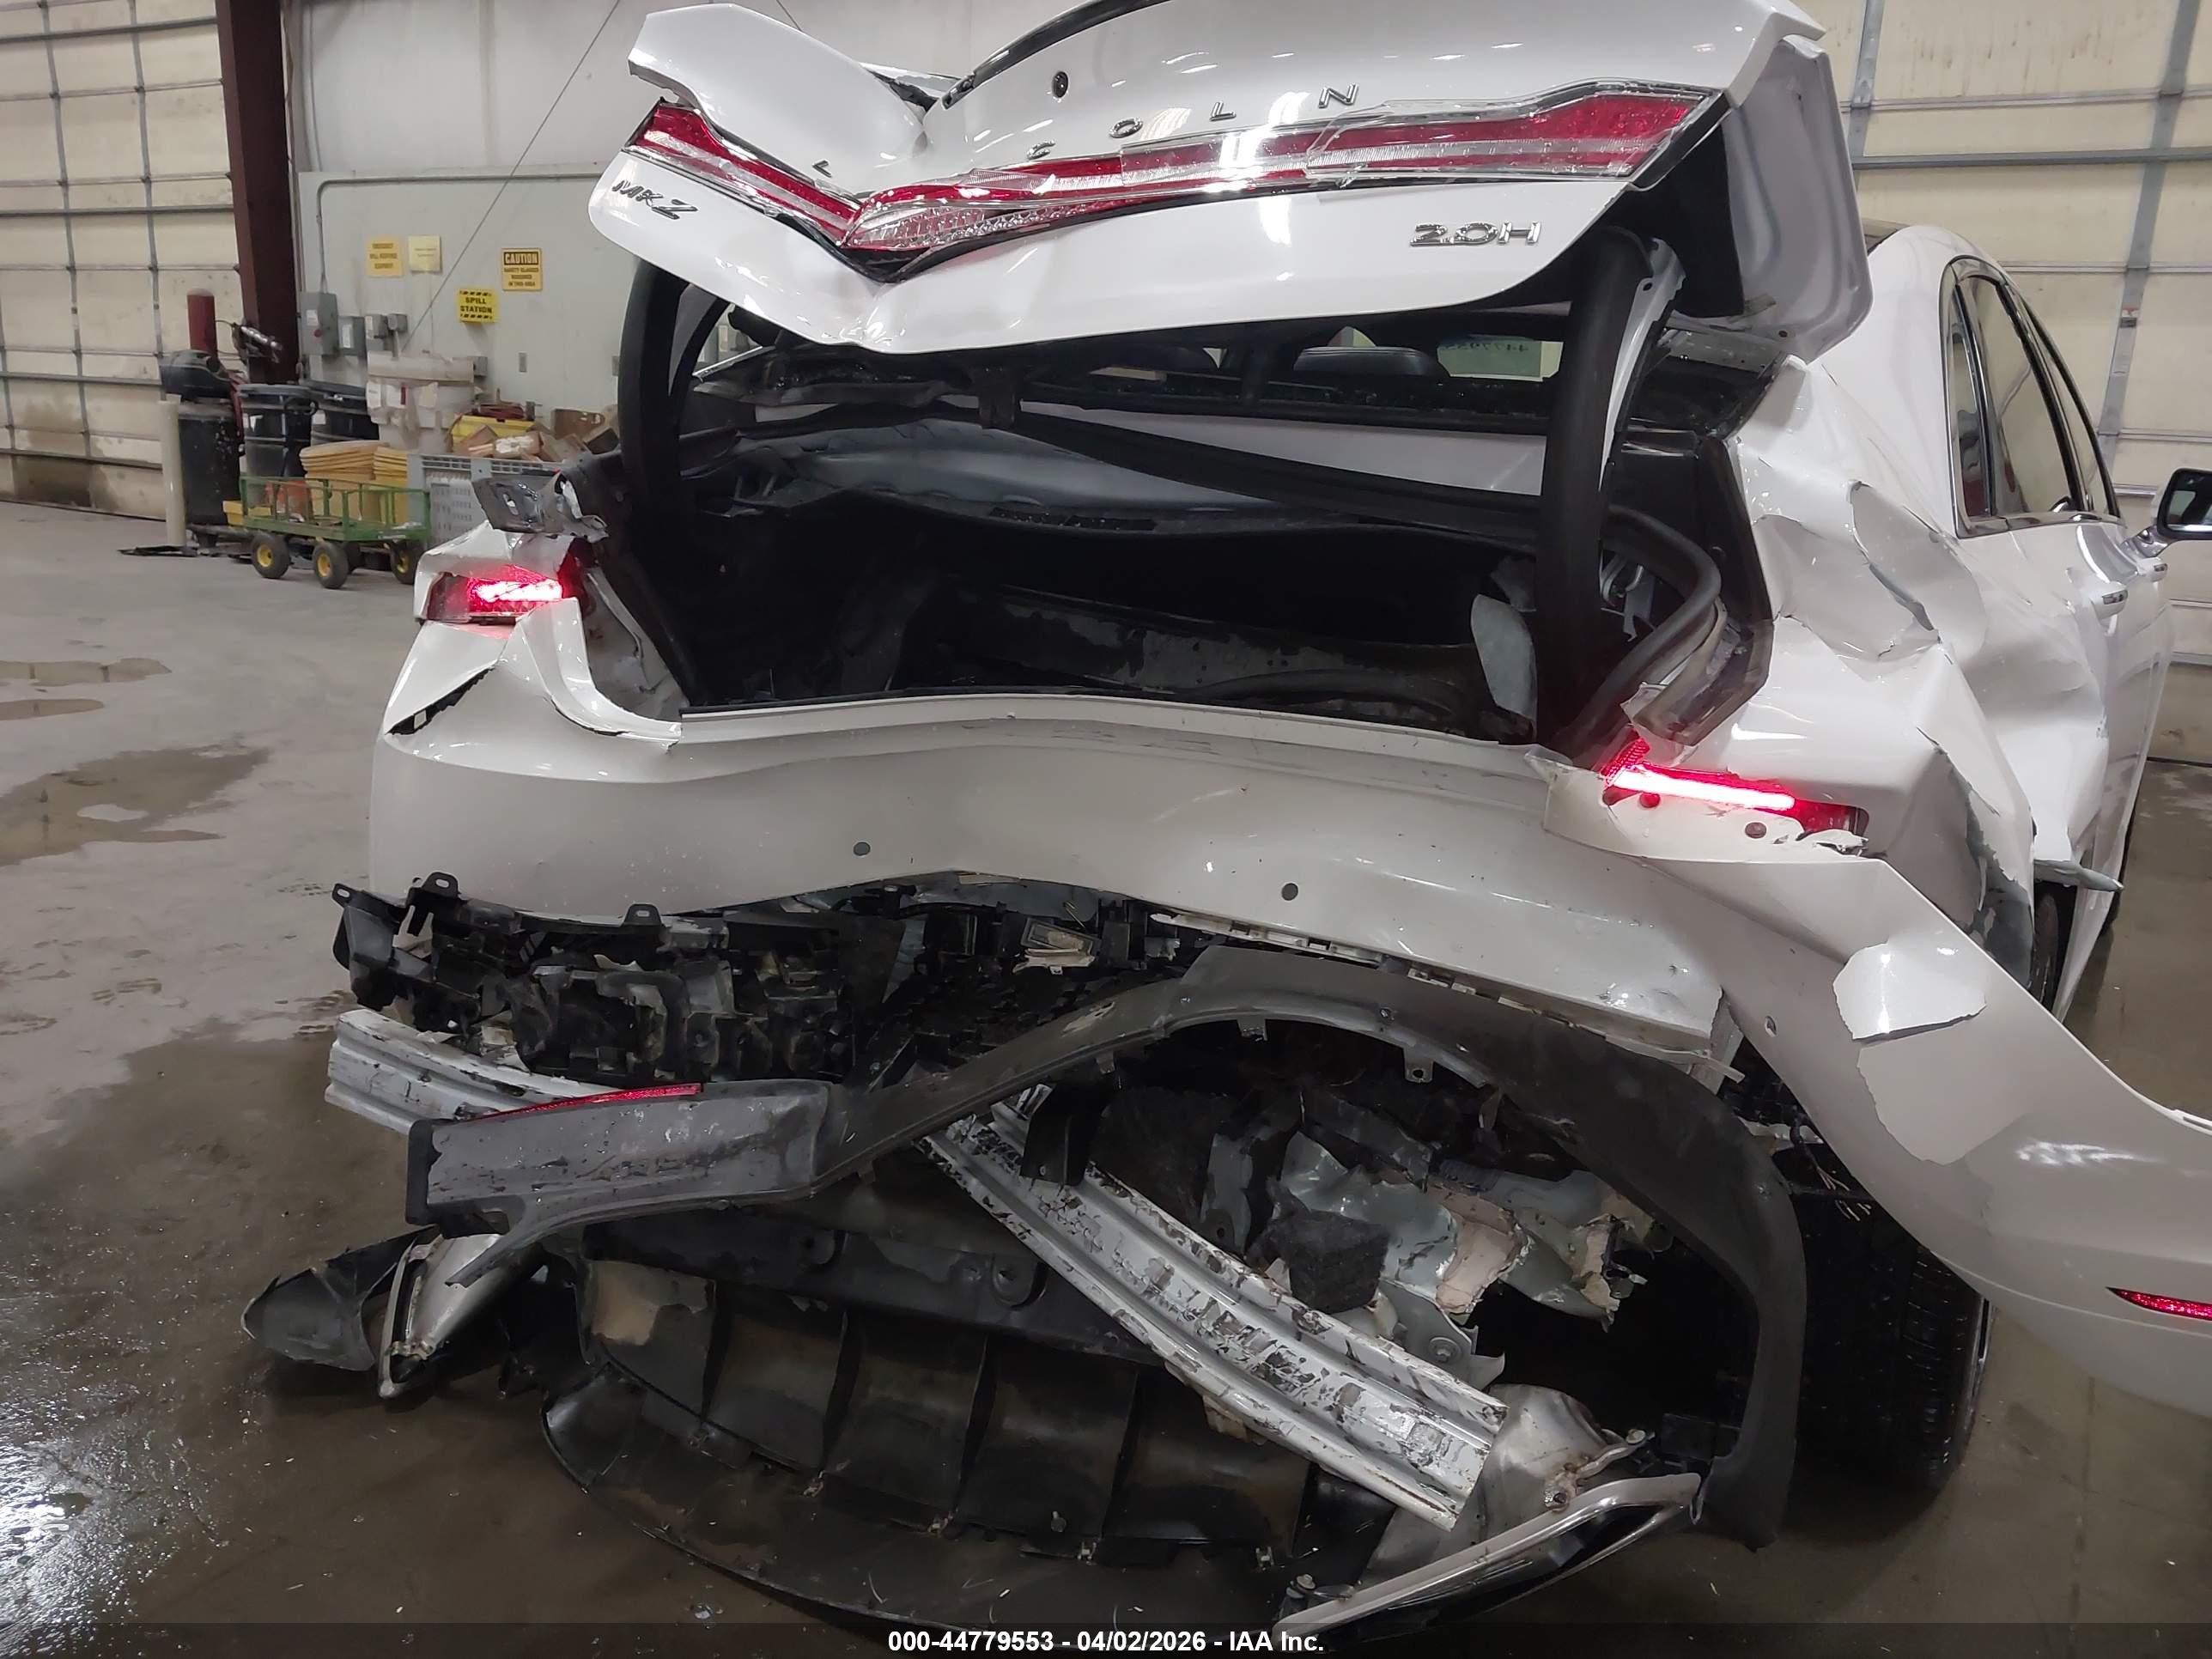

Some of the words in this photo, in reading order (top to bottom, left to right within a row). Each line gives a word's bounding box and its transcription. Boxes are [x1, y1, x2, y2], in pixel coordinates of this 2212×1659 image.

[611, 179, 698, 220] MKZ
[1409, 221, 1540, 246] 2.0H
[505, 253, 538, 264] CAUTION
